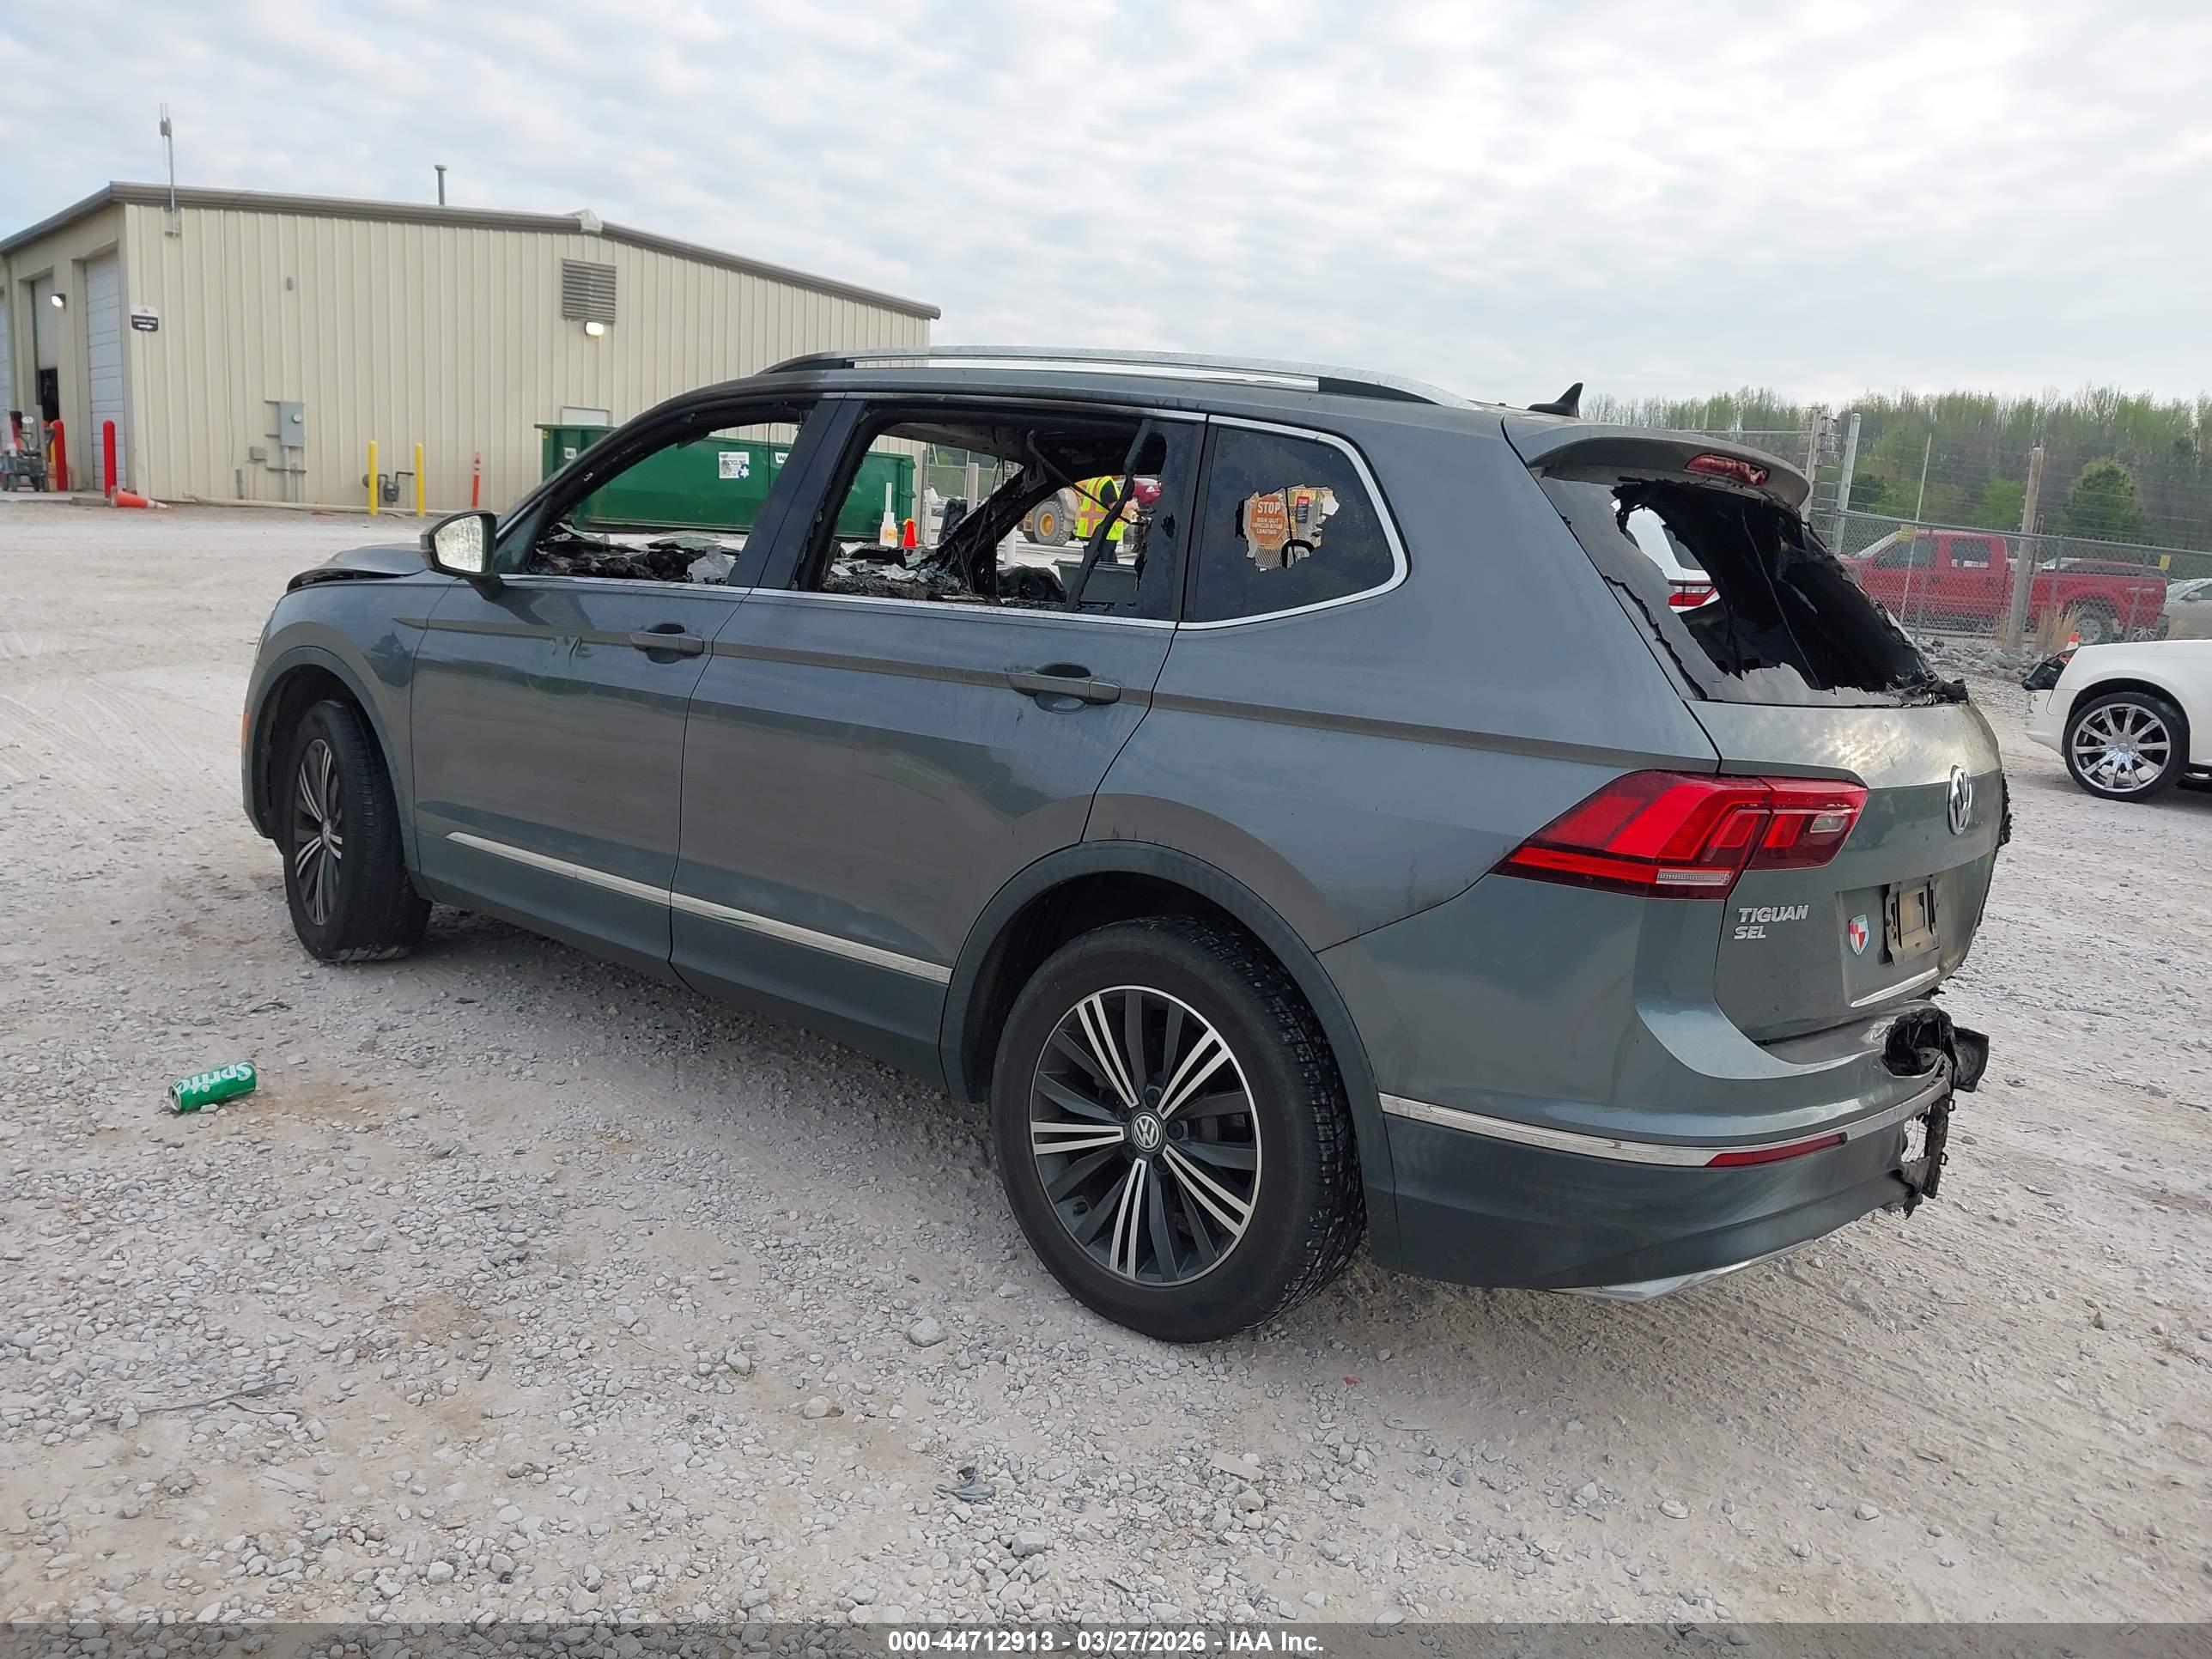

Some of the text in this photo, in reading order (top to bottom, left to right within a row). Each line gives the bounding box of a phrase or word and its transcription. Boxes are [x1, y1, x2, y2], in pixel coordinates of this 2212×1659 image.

[1257, 501, 1281, 514] STOP
[1738, 904, 1809, 923] TIGUAN
[1733, 925, 1766, 940] SEL
[175, 1061, 252, 1095] Sprite
